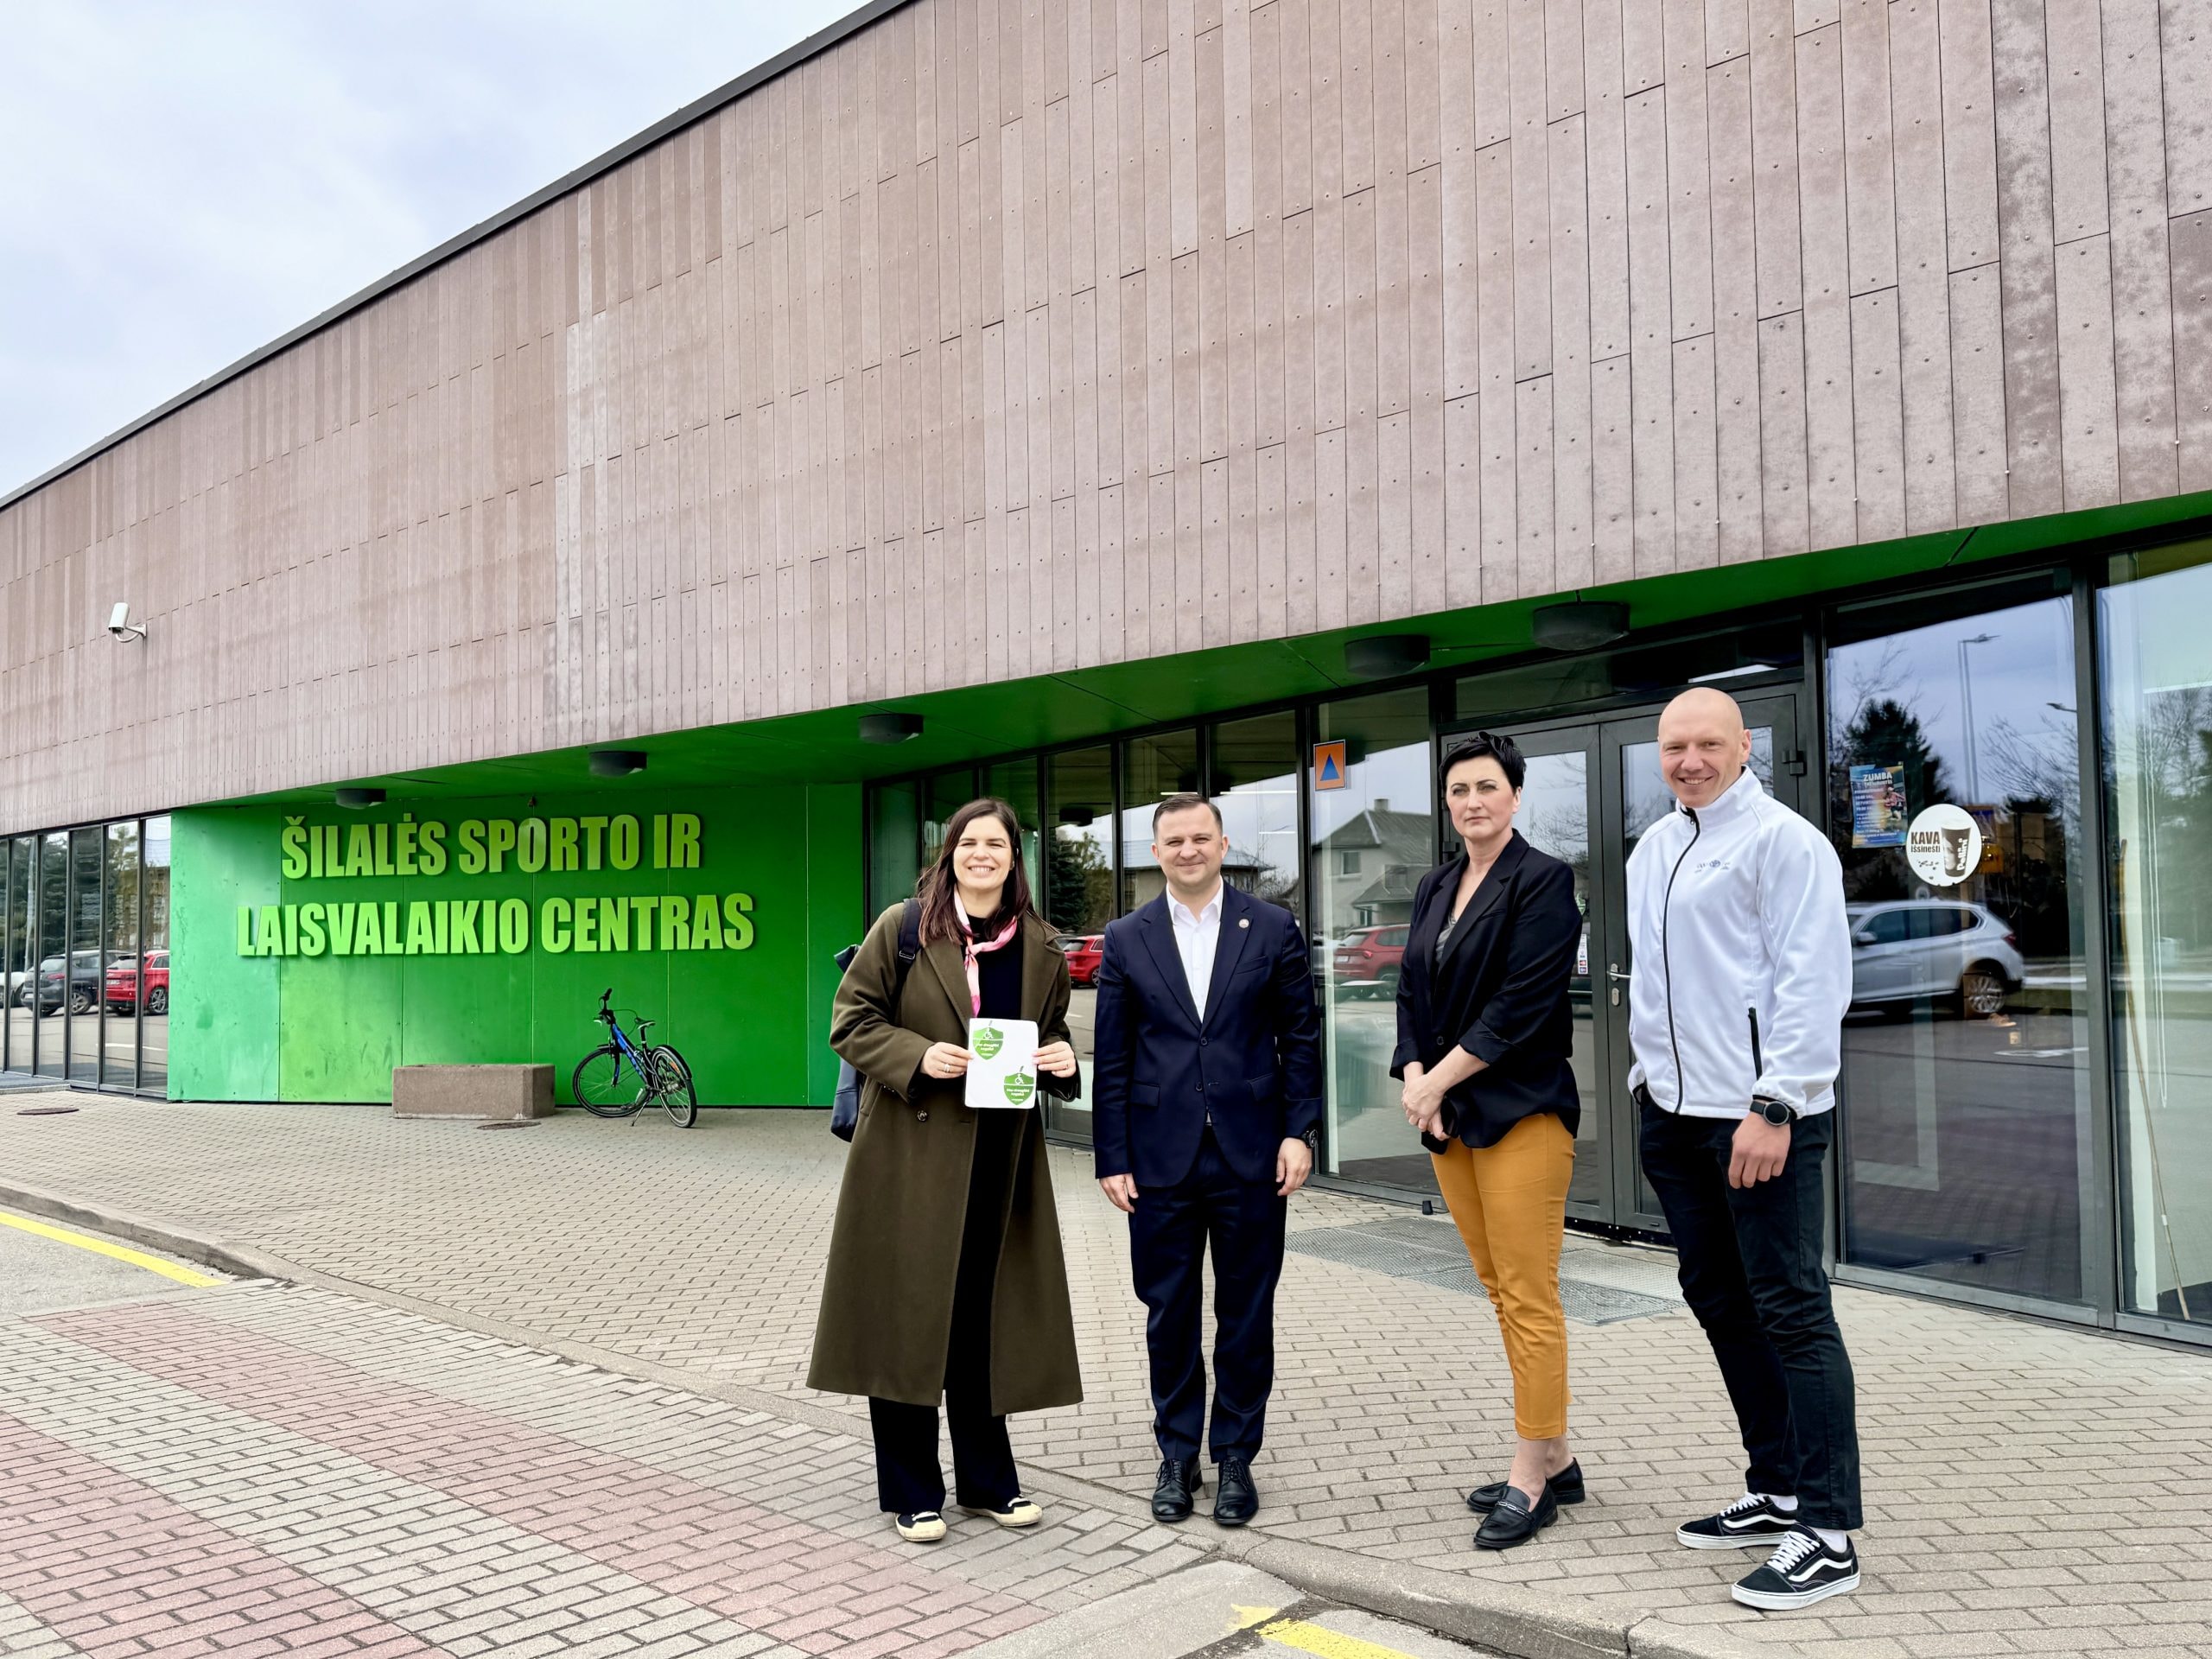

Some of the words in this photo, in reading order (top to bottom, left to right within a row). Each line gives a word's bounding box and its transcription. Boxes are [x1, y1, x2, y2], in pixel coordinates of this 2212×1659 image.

[1863, 772, 1893, 782] ZUMBA
[281, 814, 447, 880] ŠILALĖS
[458, 815, 640, 875] SPORTO
[653, 813, 702, 868] IR
[1910, 831, 1940, 844] KAVA
[237, 899, 529, 957] LAISVALAIKIO
[541, 893, 754, 953] CENTRAS
